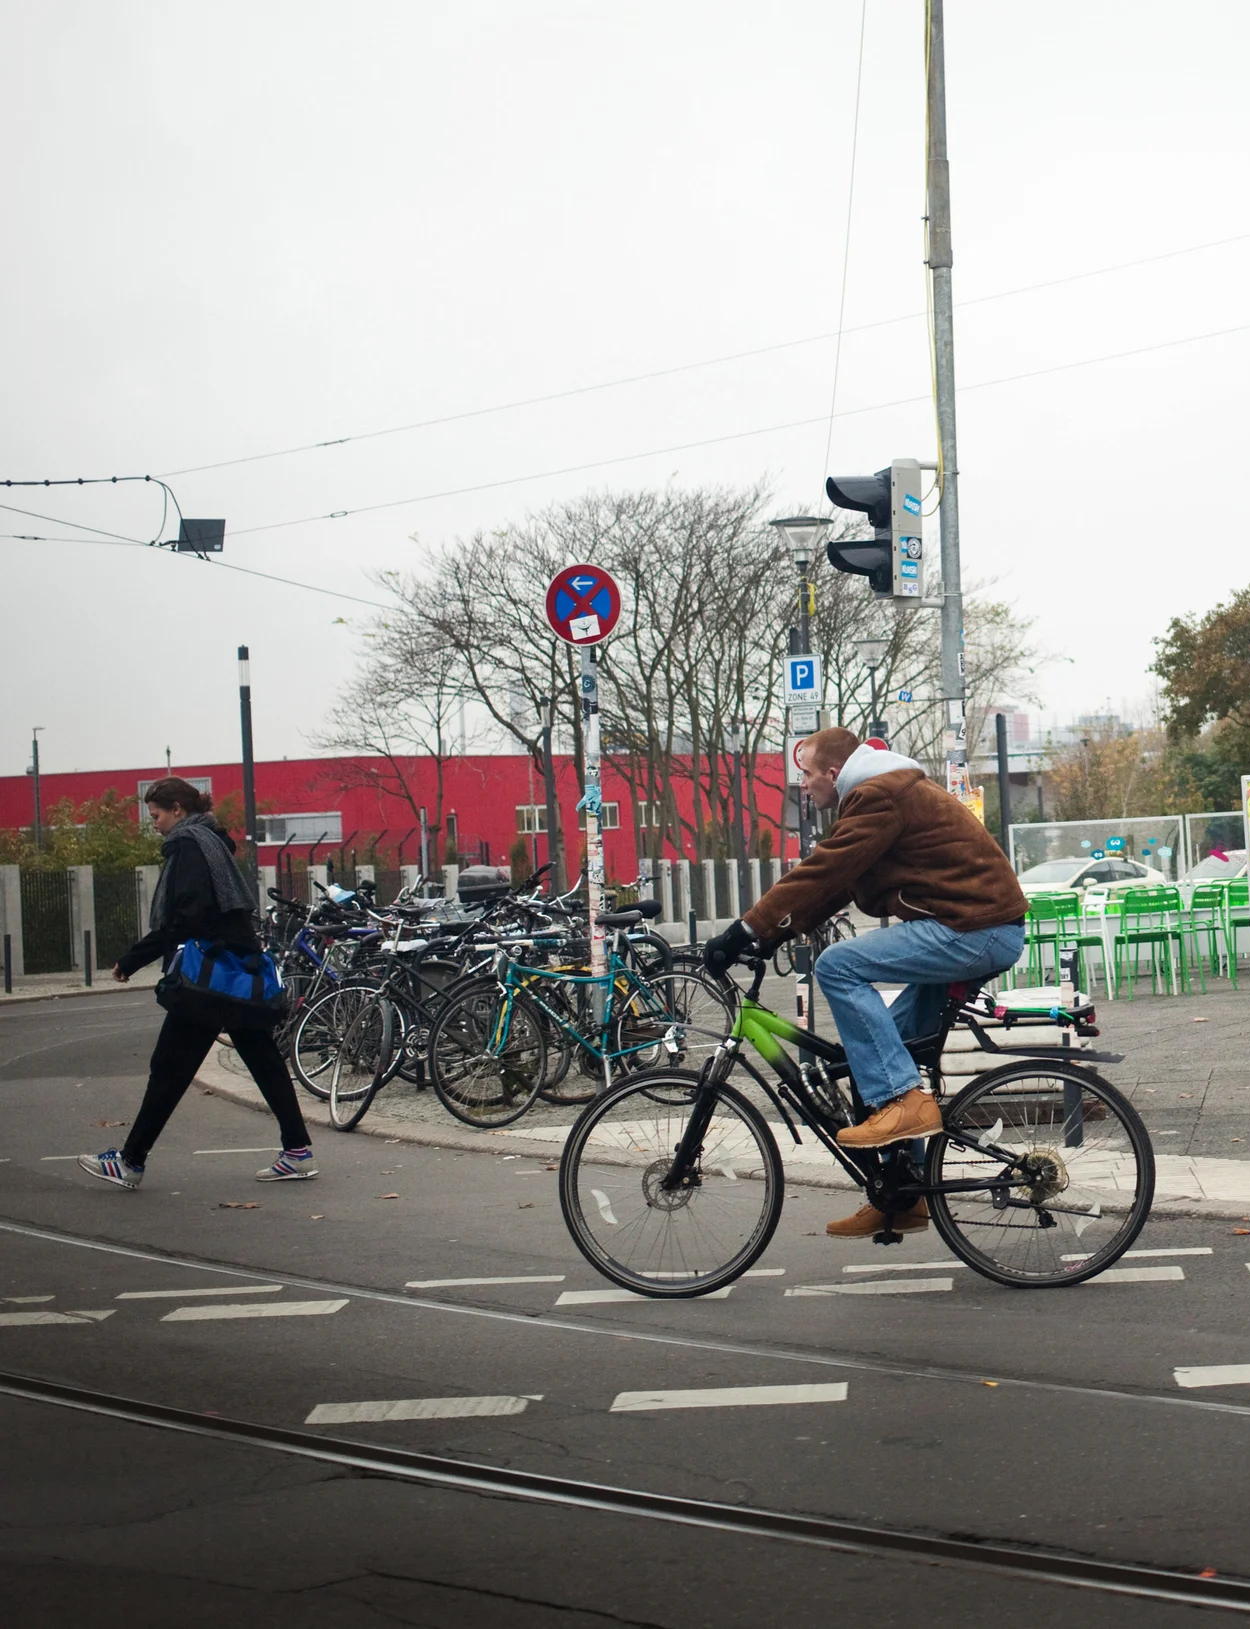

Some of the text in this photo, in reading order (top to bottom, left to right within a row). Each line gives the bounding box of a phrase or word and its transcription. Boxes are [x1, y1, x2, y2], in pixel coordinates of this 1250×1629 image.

[797, 665, 808, 686] P
[788, 692, 819, 702] ZONE 49
